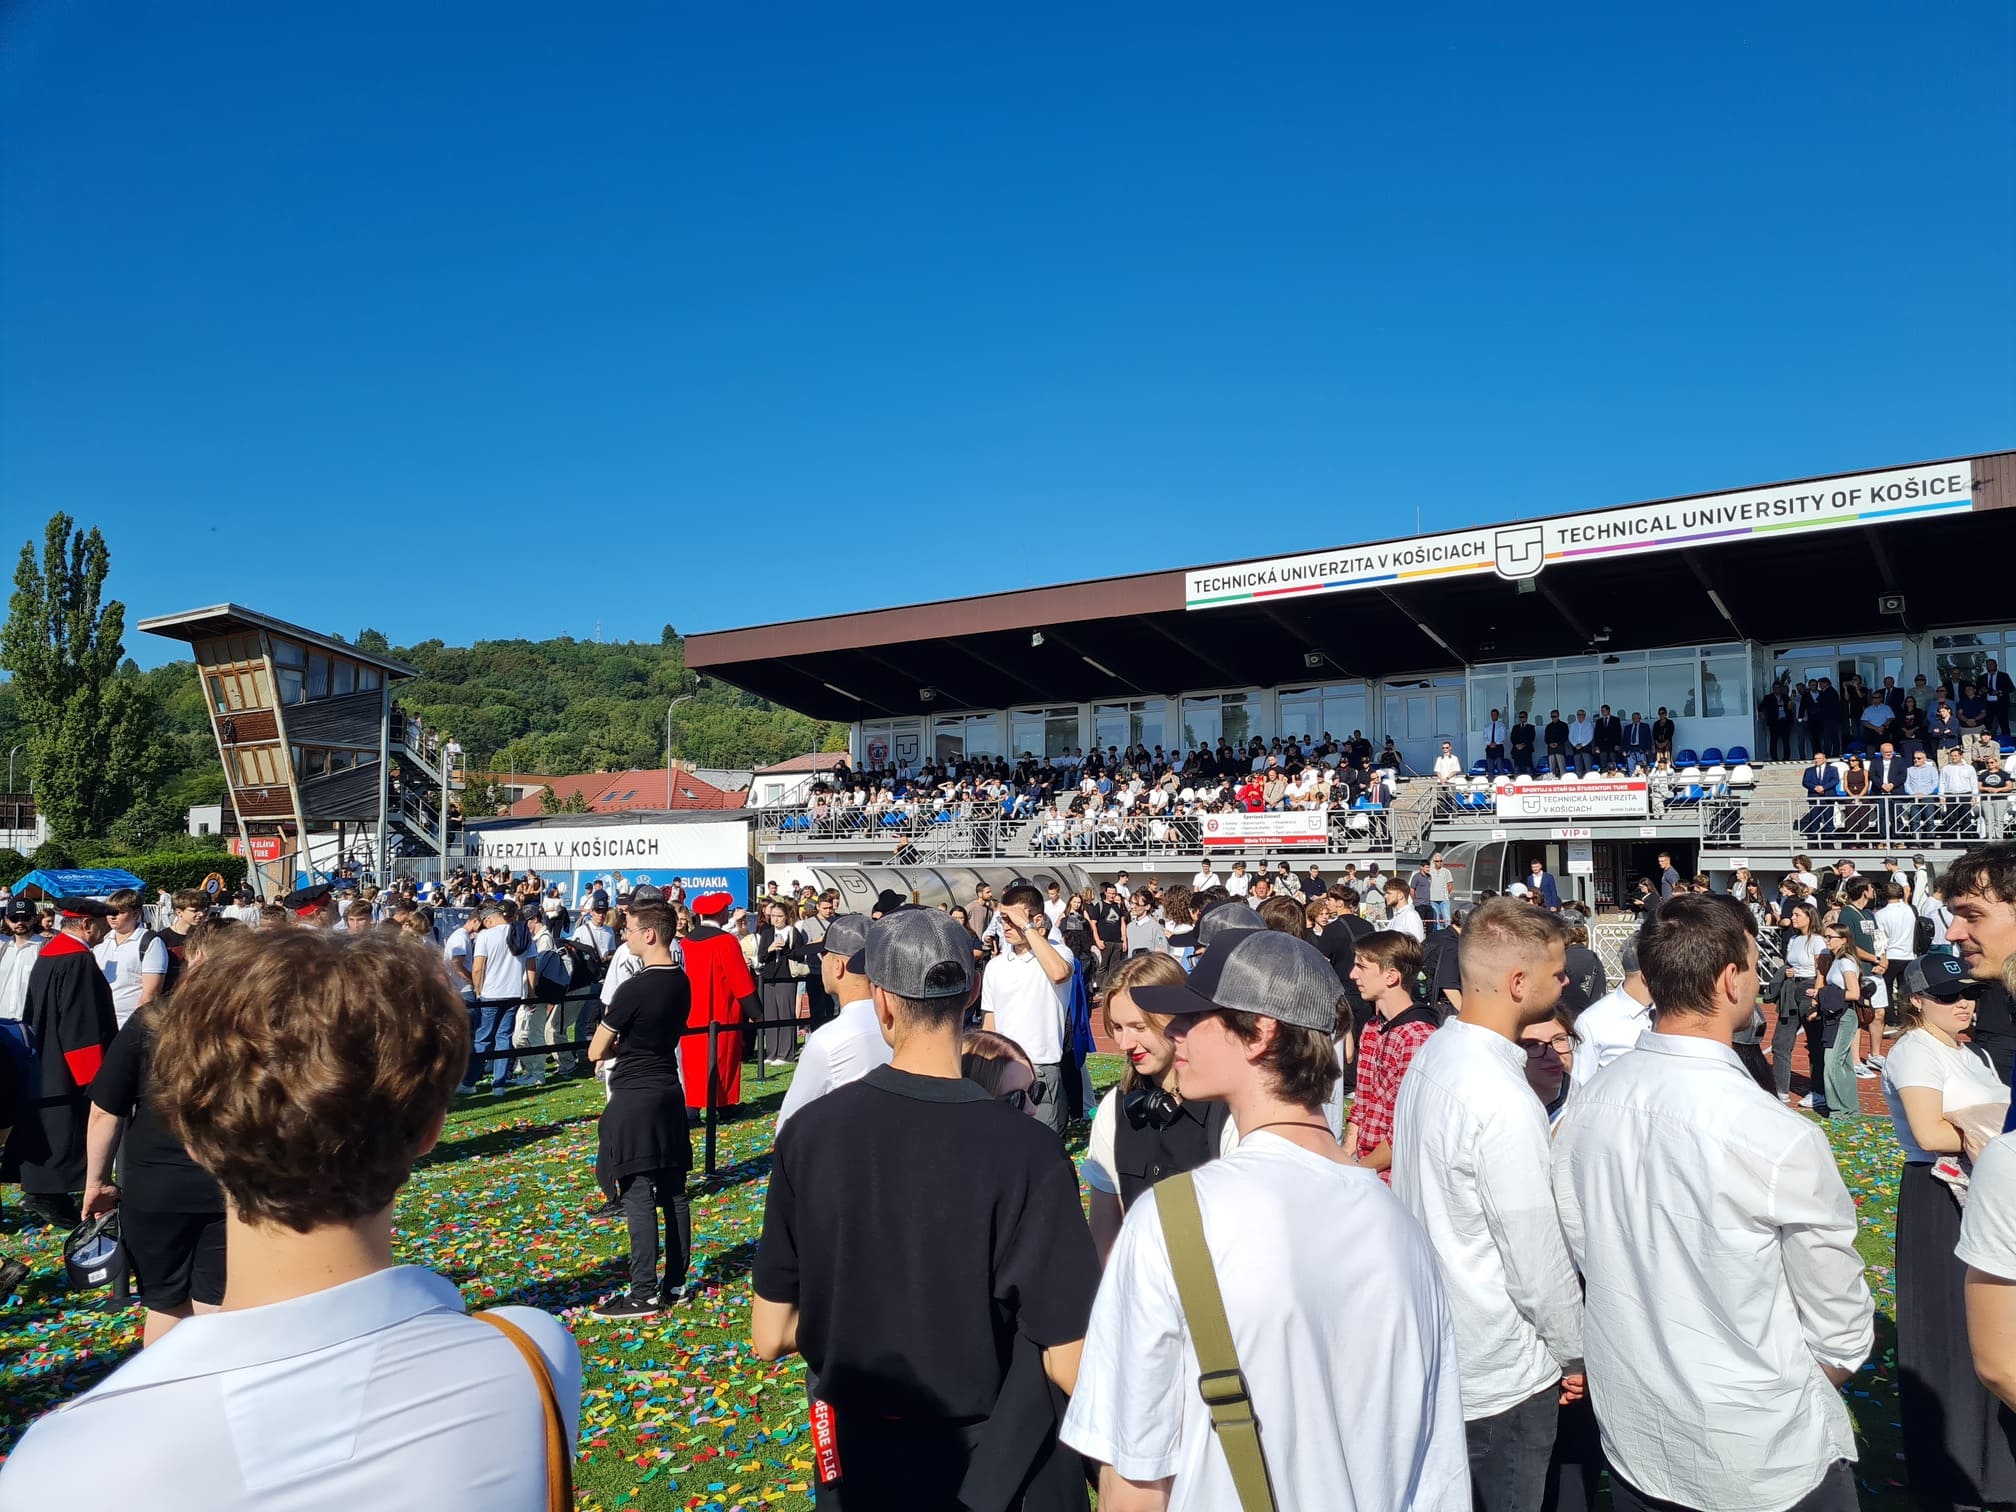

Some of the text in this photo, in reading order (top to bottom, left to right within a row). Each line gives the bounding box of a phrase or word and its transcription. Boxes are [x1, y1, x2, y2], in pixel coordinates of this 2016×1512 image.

[1557, 475, 1963, 544] TECHNICAL UNIVERSITY OF KOŠICE
[1194, 541, 1486, 593] TECHNICKÁ UNIVERZITA V KOŠICIACH
[1543, 793, 1638, 803] TECHNICKÁ UNIVERZITA
[1550, 805, 1592, 813] KOŠICIACH
[1561, 829, 1581, 837] VIP
[554, 842, 564, 857] V
[571, 837, 659, 857] KOŠICIACH
[681, 876, 728, 888] SLOVAKIA
